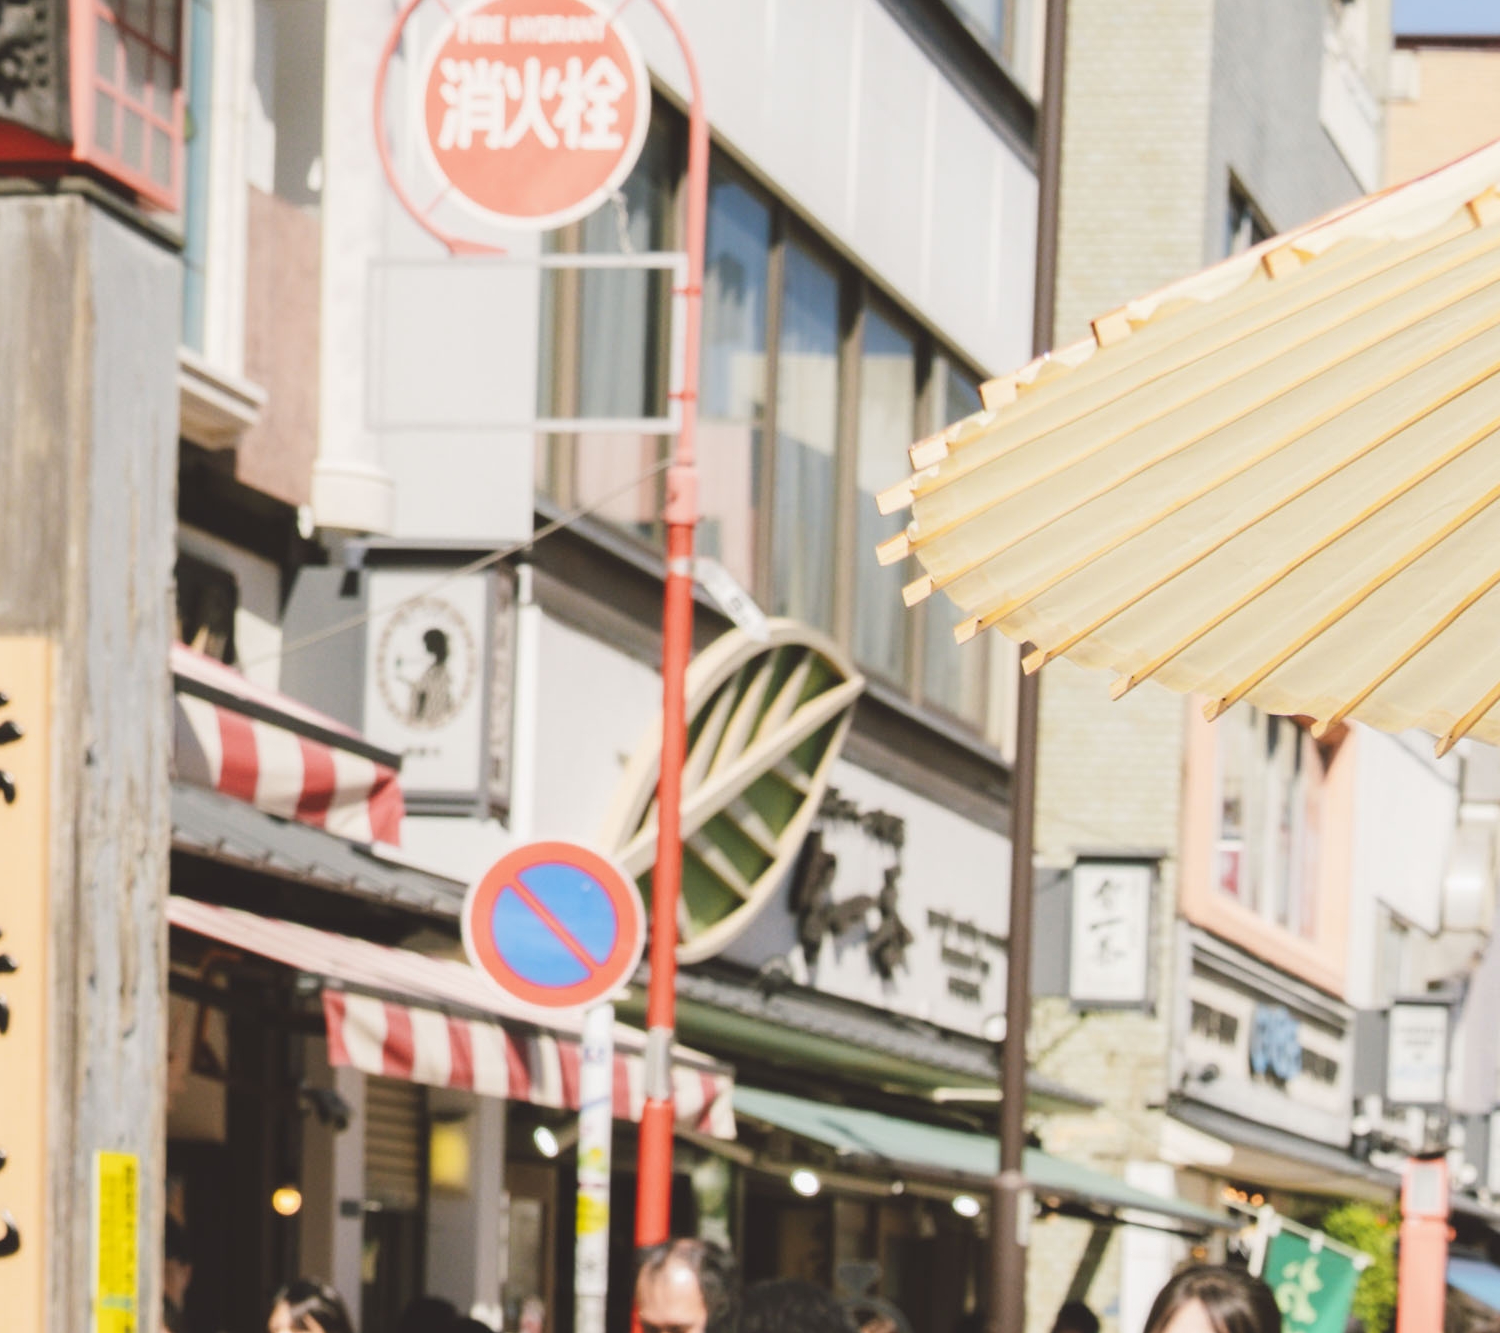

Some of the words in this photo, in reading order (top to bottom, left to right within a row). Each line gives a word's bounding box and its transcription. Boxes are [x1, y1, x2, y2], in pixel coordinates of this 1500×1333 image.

[457, 15, 506, 46] FIRE
[510, 15, 608, 45] HYDRANT
[437, 56, 628, 150] 消火栓
